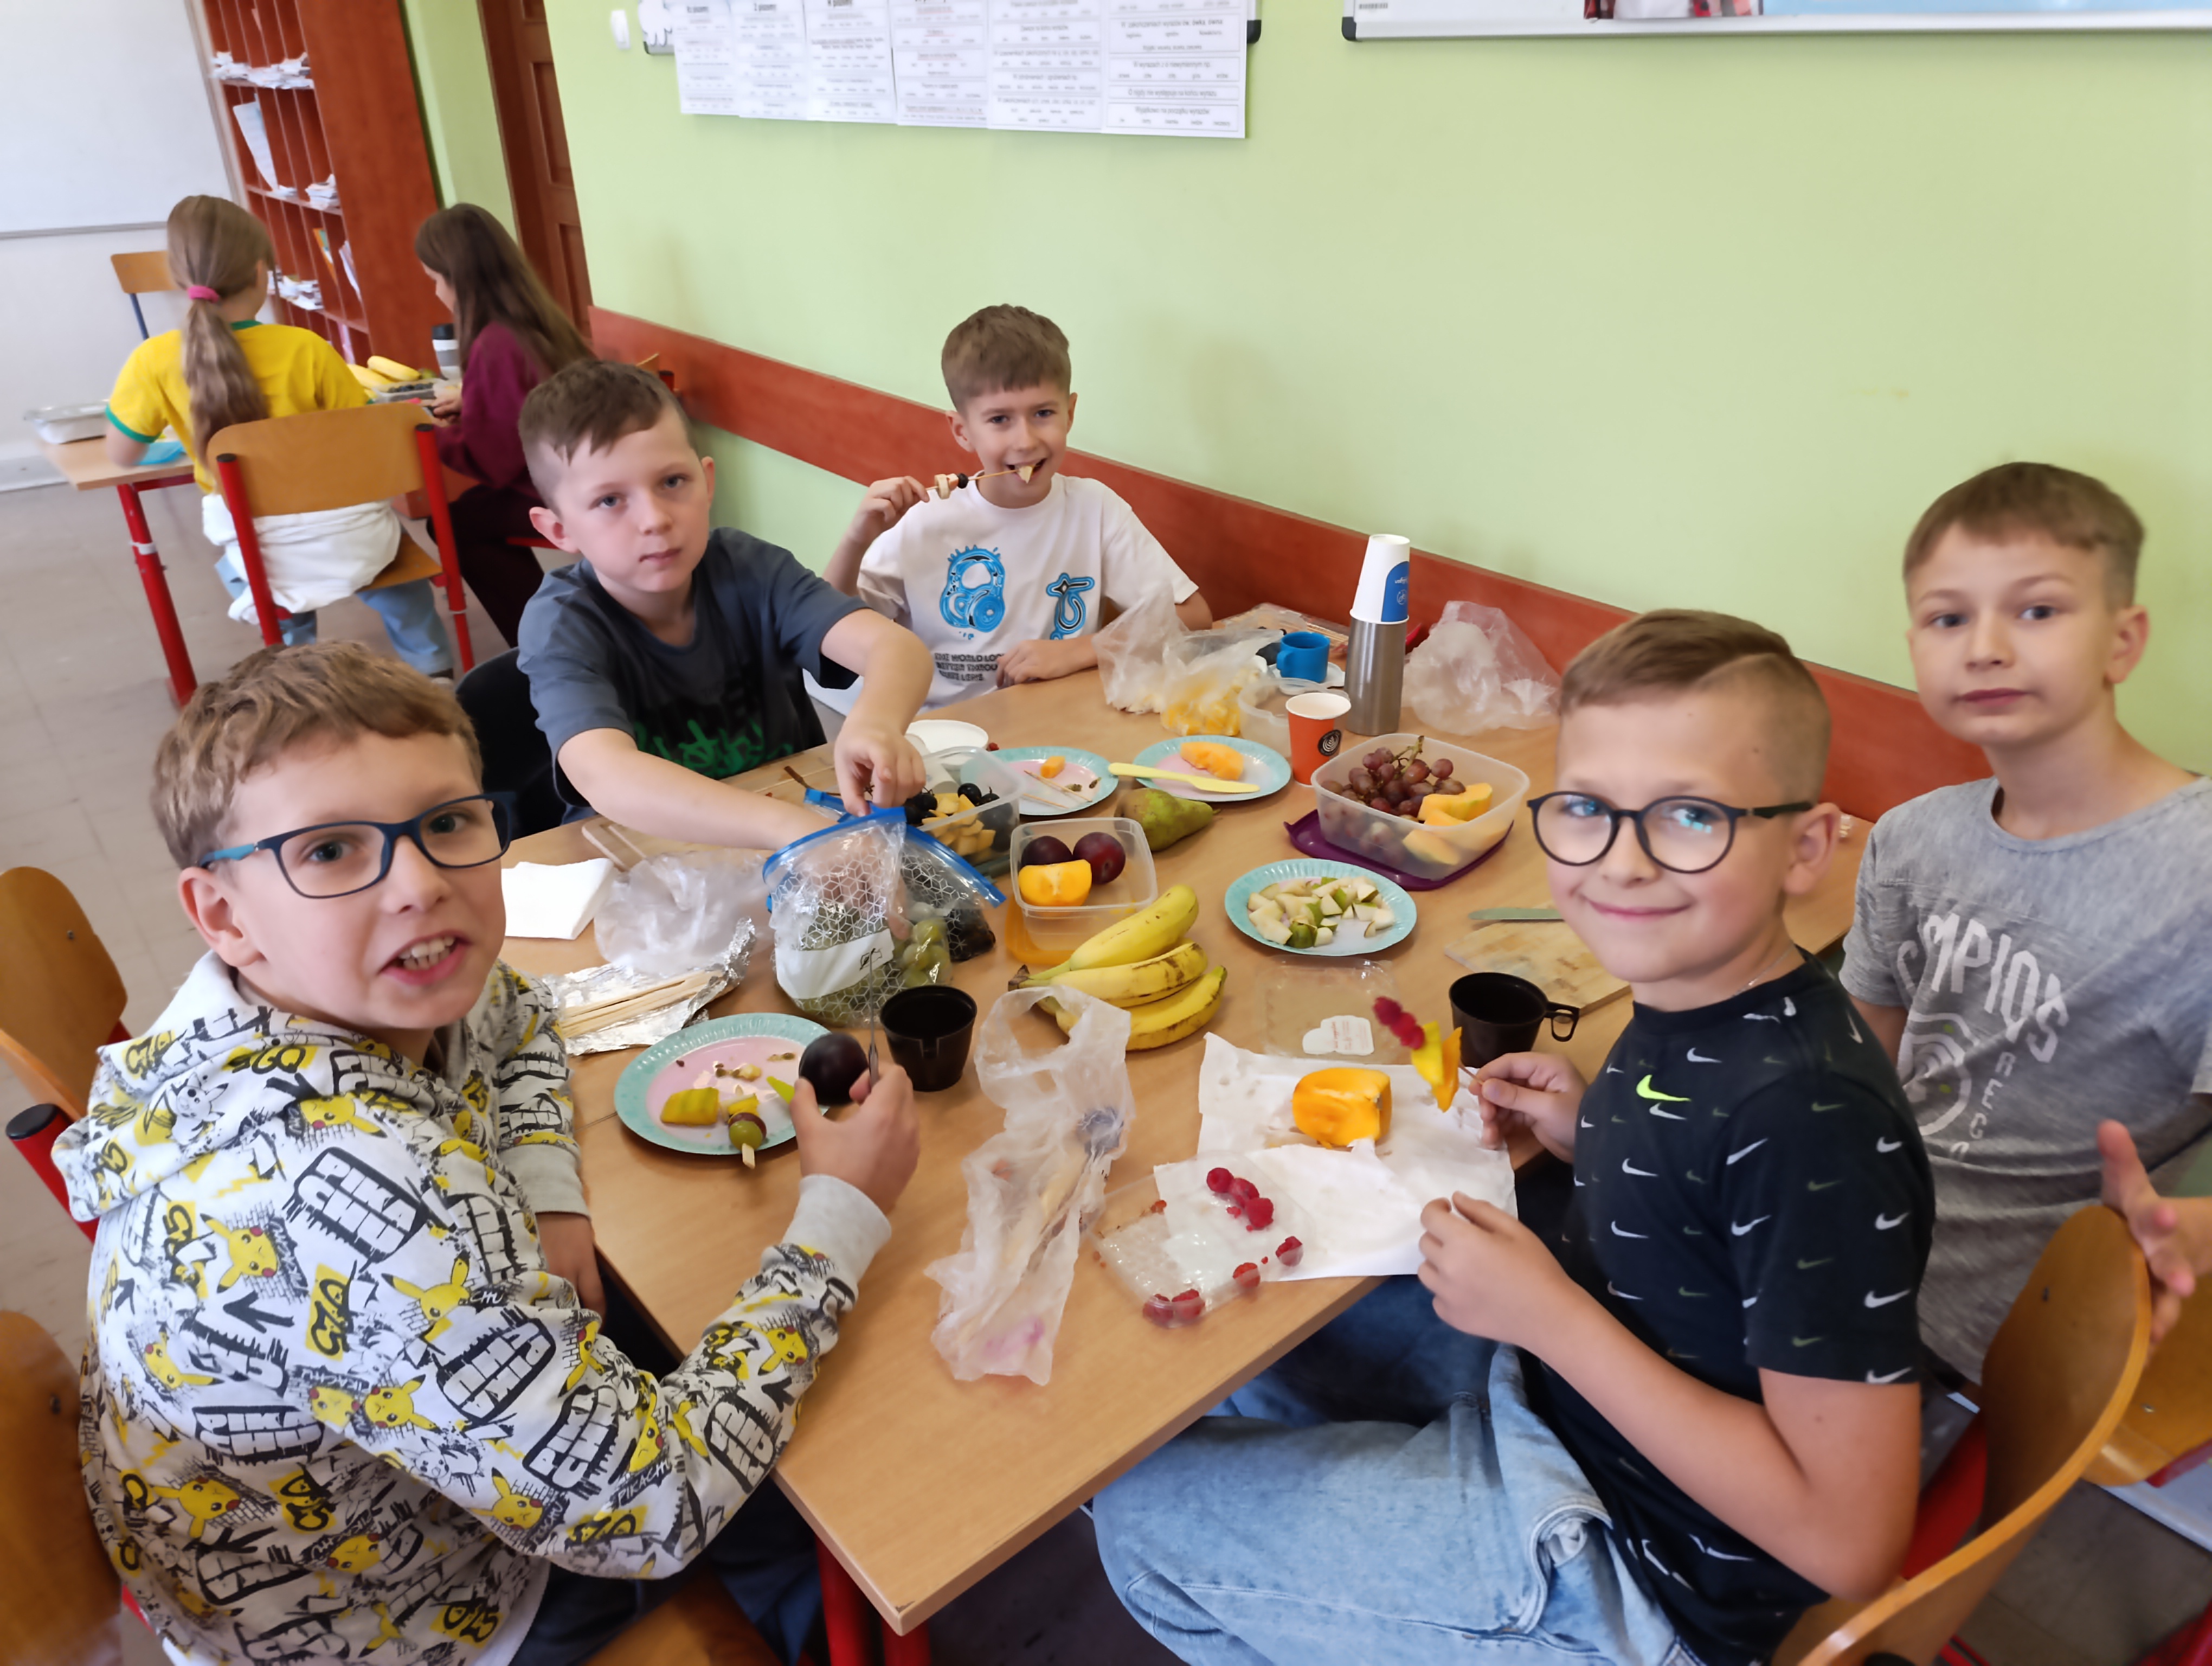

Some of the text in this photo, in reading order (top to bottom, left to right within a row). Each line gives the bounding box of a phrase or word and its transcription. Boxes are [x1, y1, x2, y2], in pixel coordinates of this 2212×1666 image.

[951, 654, 983, 662] WORLD
[985, 653, 1004, 662] LOO
[298, 1175, 406, 1254] CHU
[316, 1152, 416, 1232] PIKA
[200, 1424, 321, 1457] CHU
[617, 1459, 671, 1506] PIKACH
